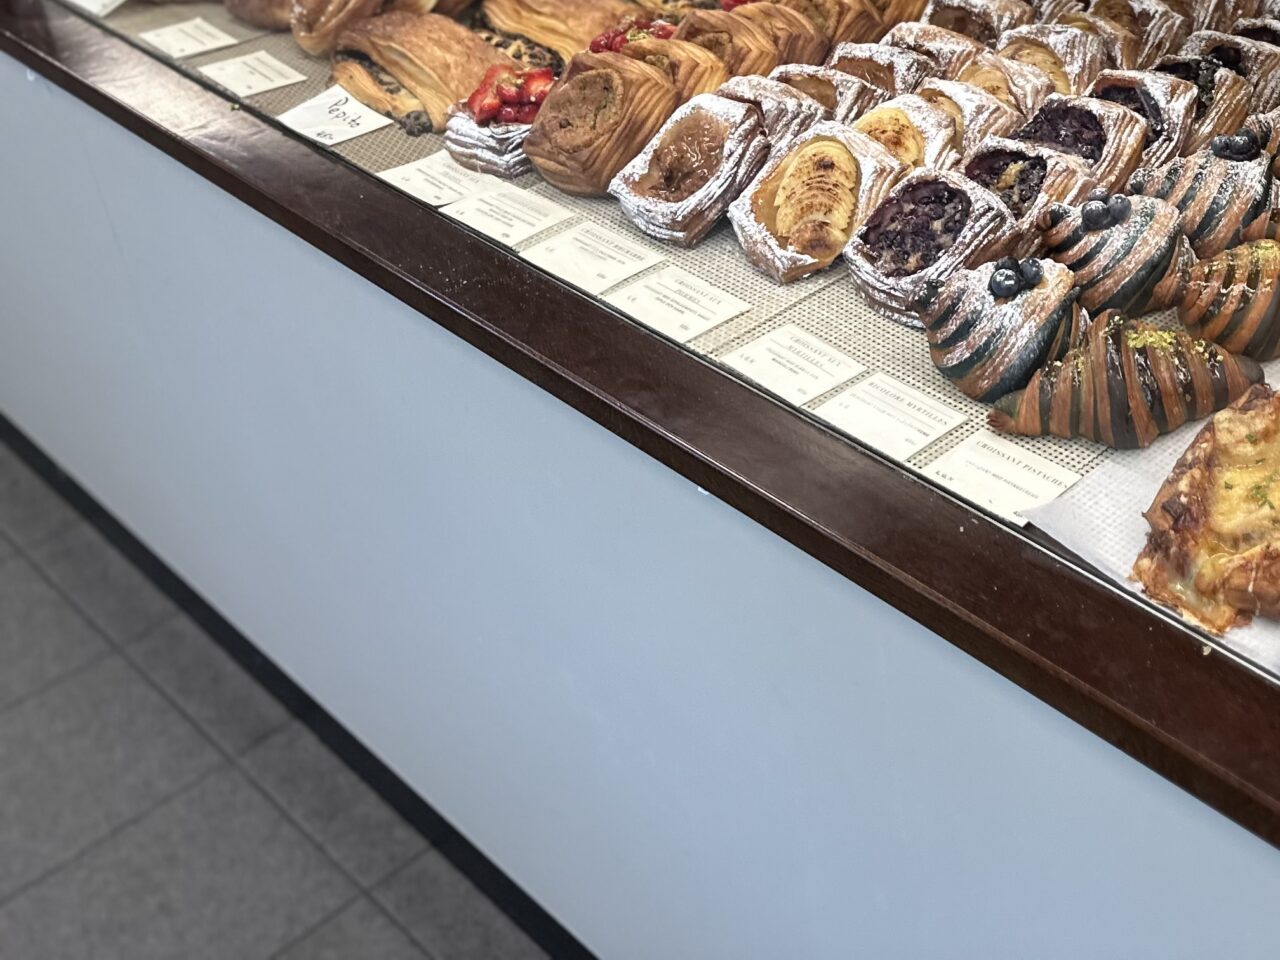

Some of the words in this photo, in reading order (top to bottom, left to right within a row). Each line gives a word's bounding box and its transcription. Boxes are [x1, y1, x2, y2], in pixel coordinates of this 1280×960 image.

[328, 96, 362, 128] Pepito
[867, 382, 906, 402] BICOLORE
[905, 401, 950, 426] MYRTILLES
[975, 441, 1023, 466] CROISSANT
